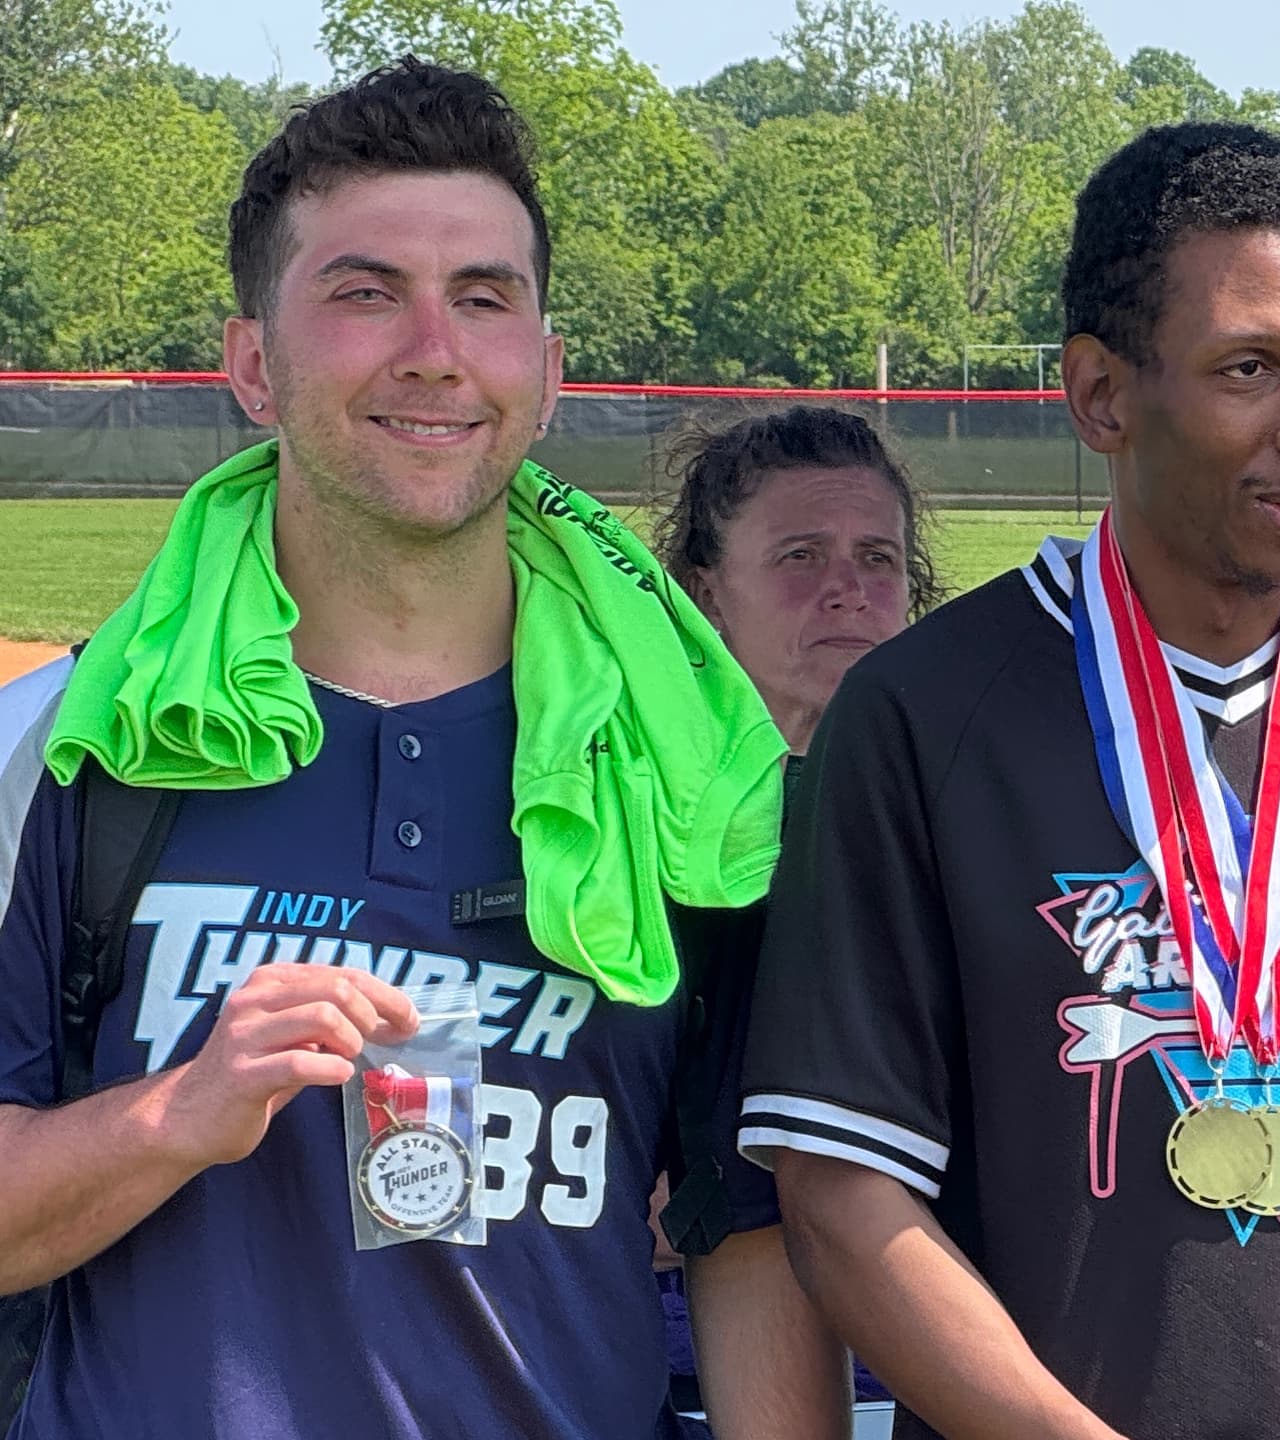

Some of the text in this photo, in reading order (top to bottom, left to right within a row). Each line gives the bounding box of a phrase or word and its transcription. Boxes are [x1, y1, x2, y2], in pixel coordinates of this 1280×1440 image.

[258, 890, 365, 932] INDY
[376, 1138, 441, 1171] ALL STAR
[379, 1161, 448, 1204] THUNDER
